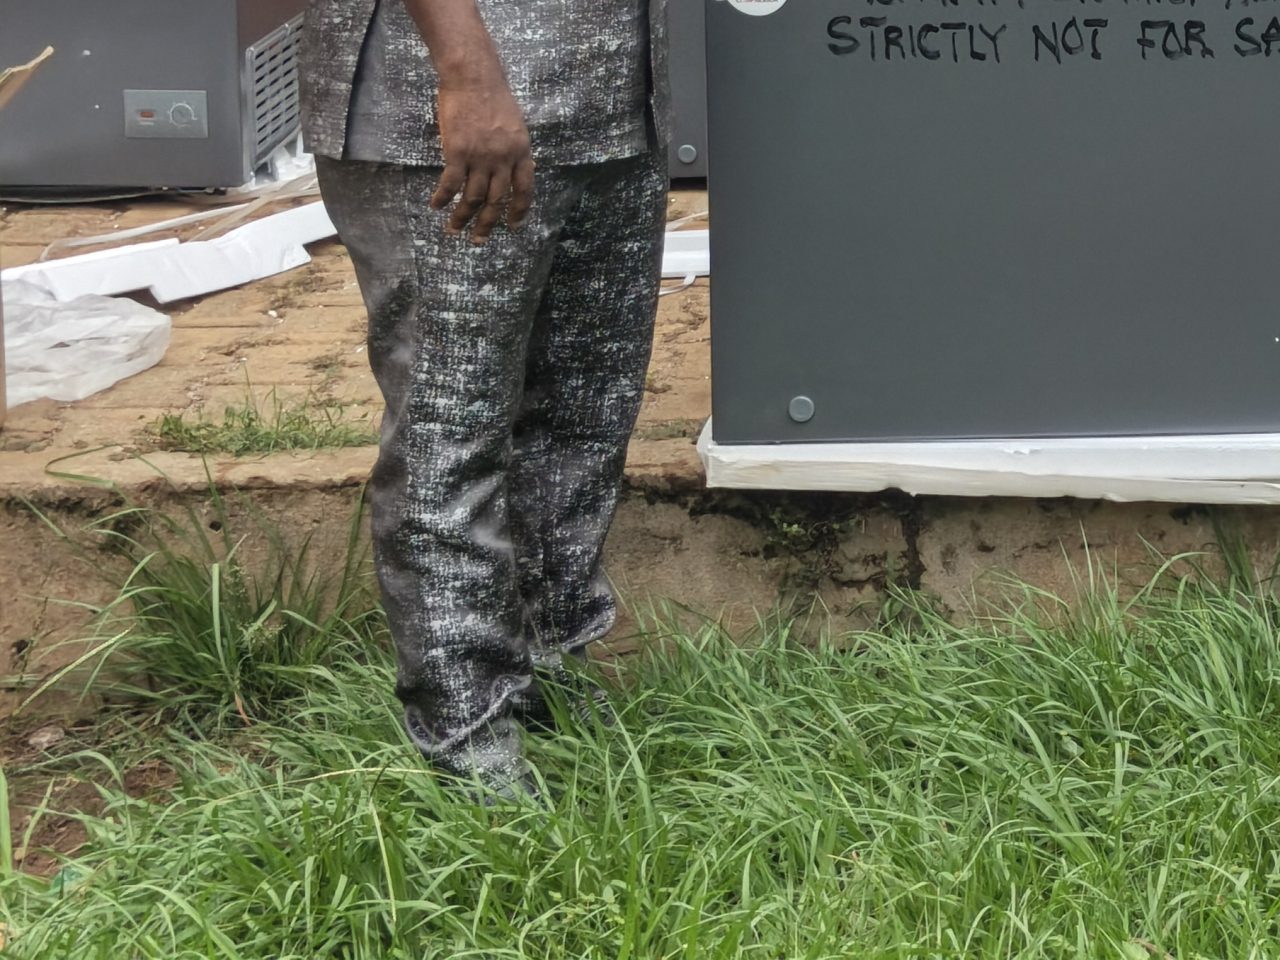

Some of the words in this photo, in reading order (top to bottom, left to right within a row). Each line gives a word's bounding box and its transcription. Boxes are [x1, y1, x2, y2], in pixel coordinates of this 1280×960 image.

[827, 15, 1007, 63] STRICTLY
[1032, 16, 1108, 64] NOT
[1137, 19, 1216, 60] FOR
